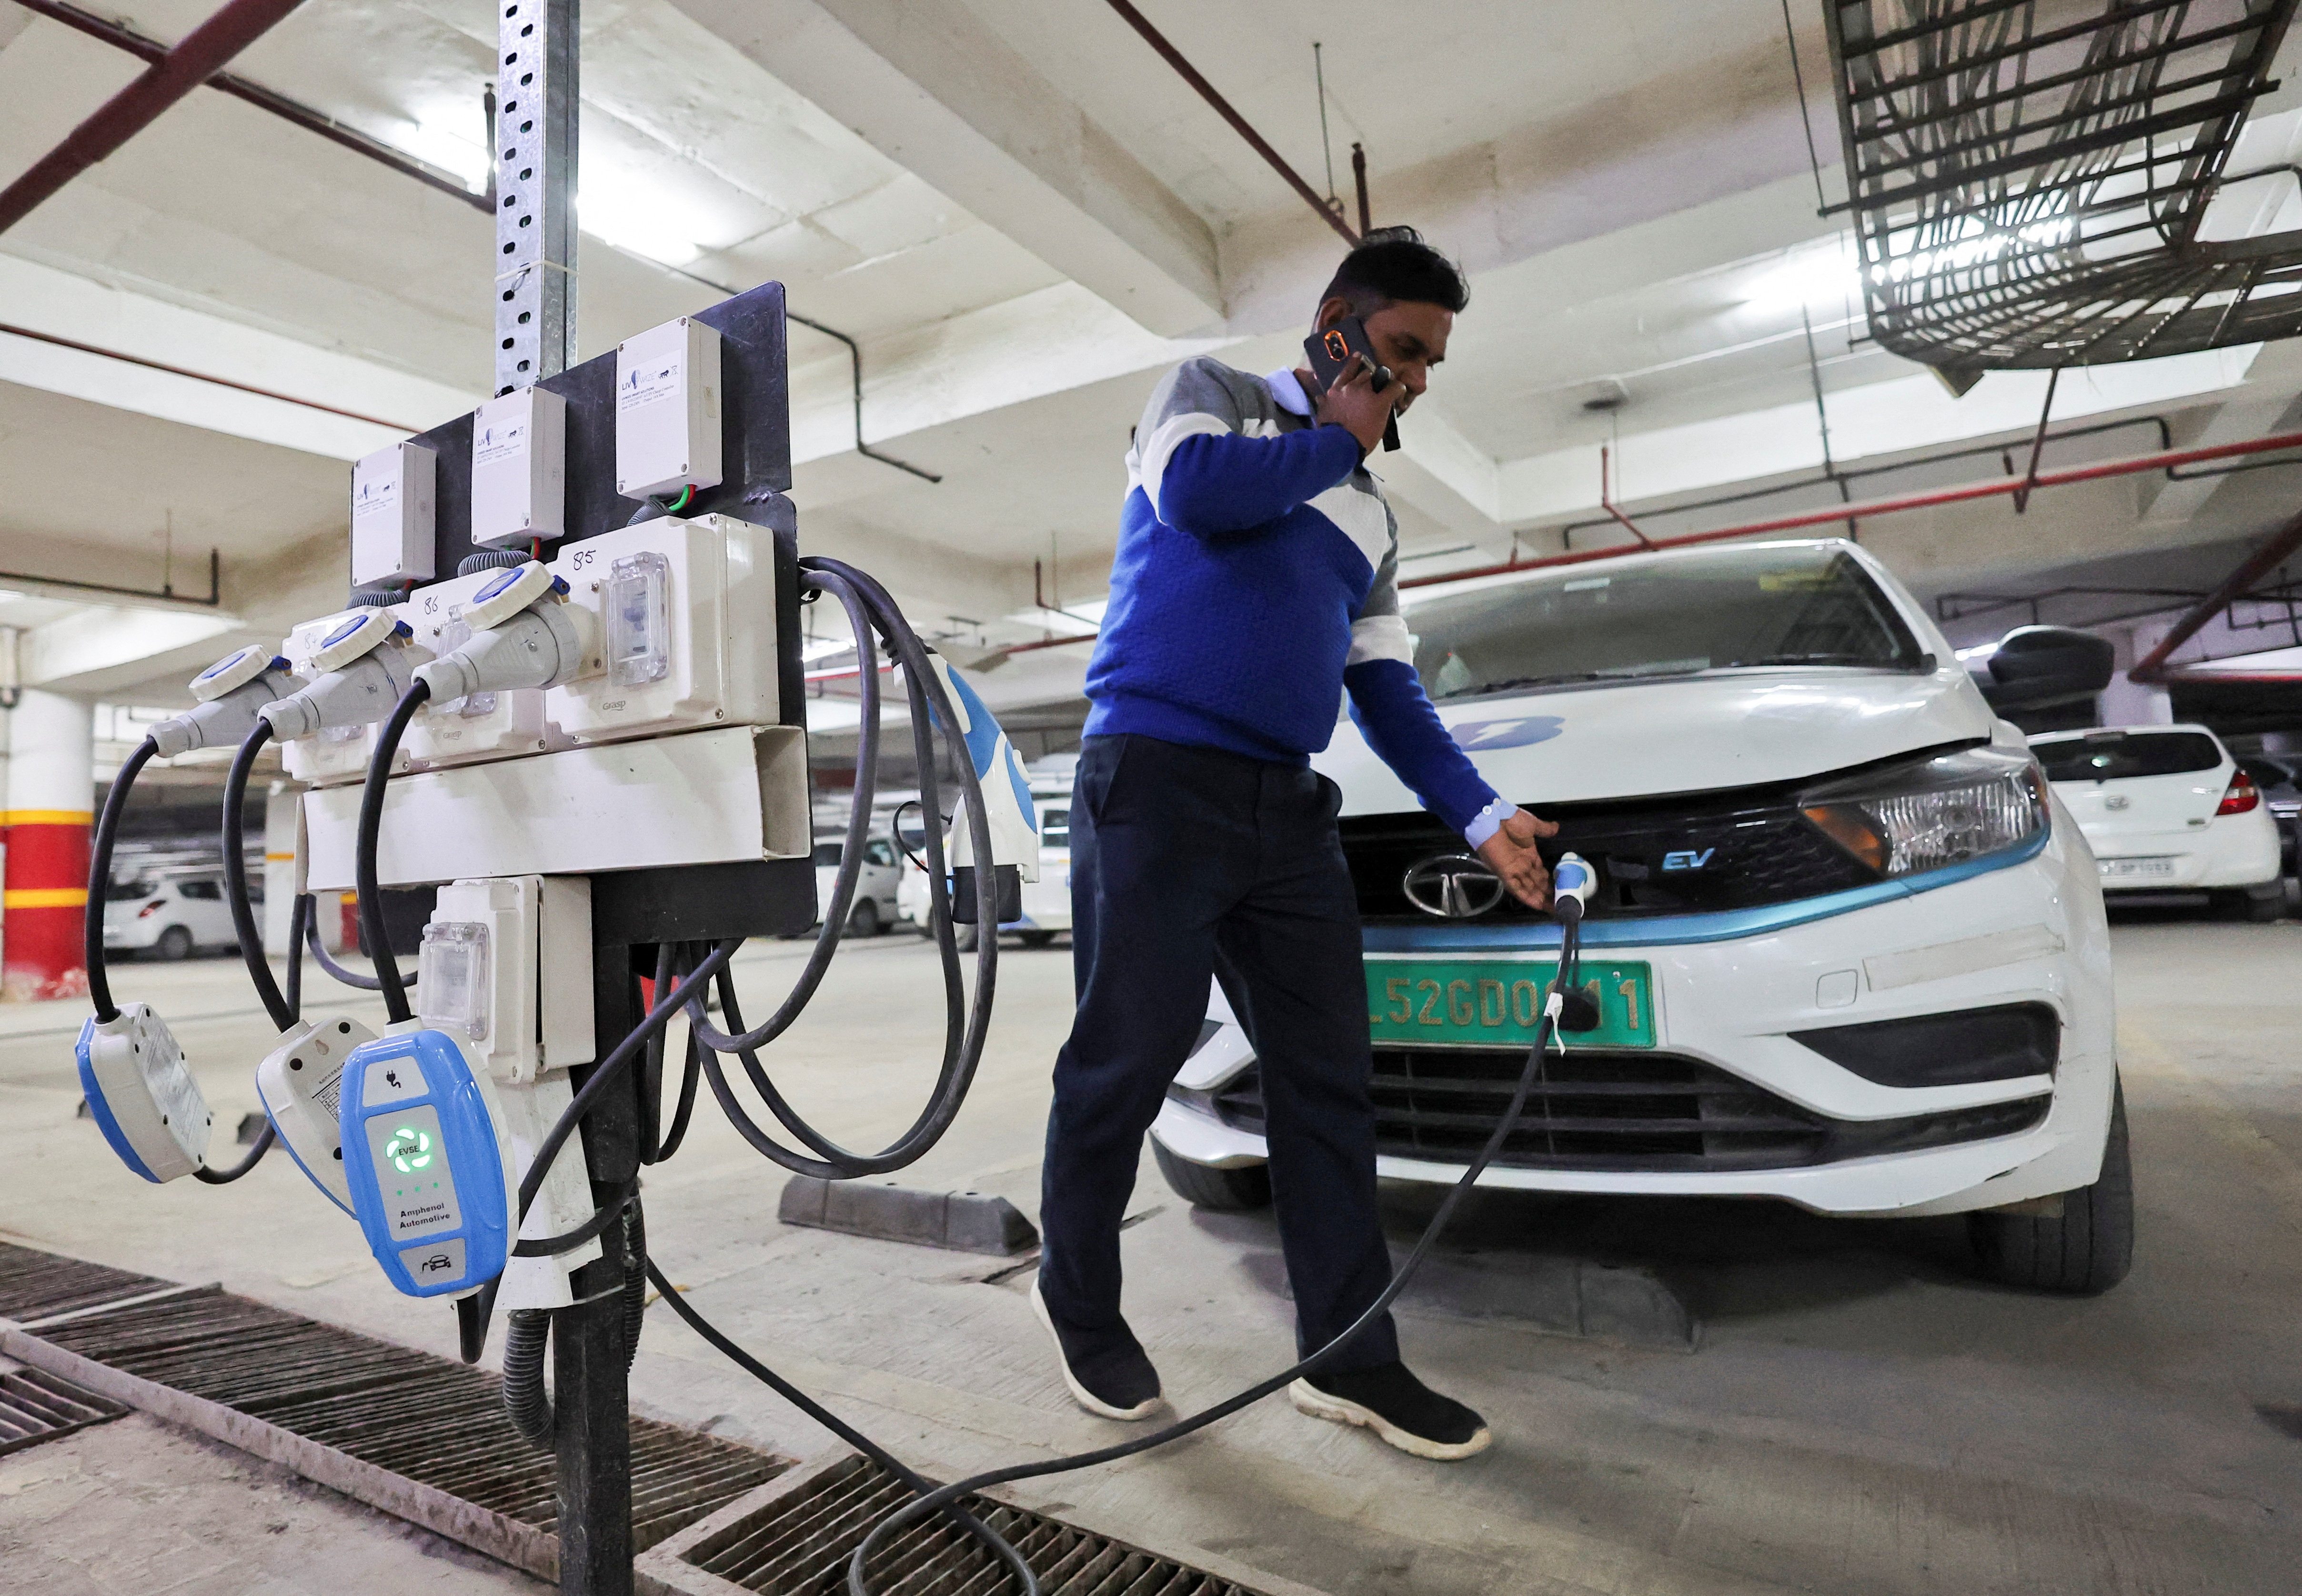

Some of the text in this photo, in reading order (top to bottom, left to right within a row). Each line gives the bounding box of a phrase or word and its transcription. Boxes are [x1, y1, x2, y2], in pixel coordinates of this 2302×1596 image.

[622, 381, 631, 391] LIV
[573, 550, 596, 571] 85
[424, 595, 438, 615] 86
[603, 700, 626, 711] Grasp
[1662, 847, 1716, 870] EV
[1370, 978, 1639, 1030] 52GD01
[398, 1145, 419, 1156] EVSE
[401, 1202, 444, 1217] Amphenol
[400, 1214, 450, 1229] Automotive
